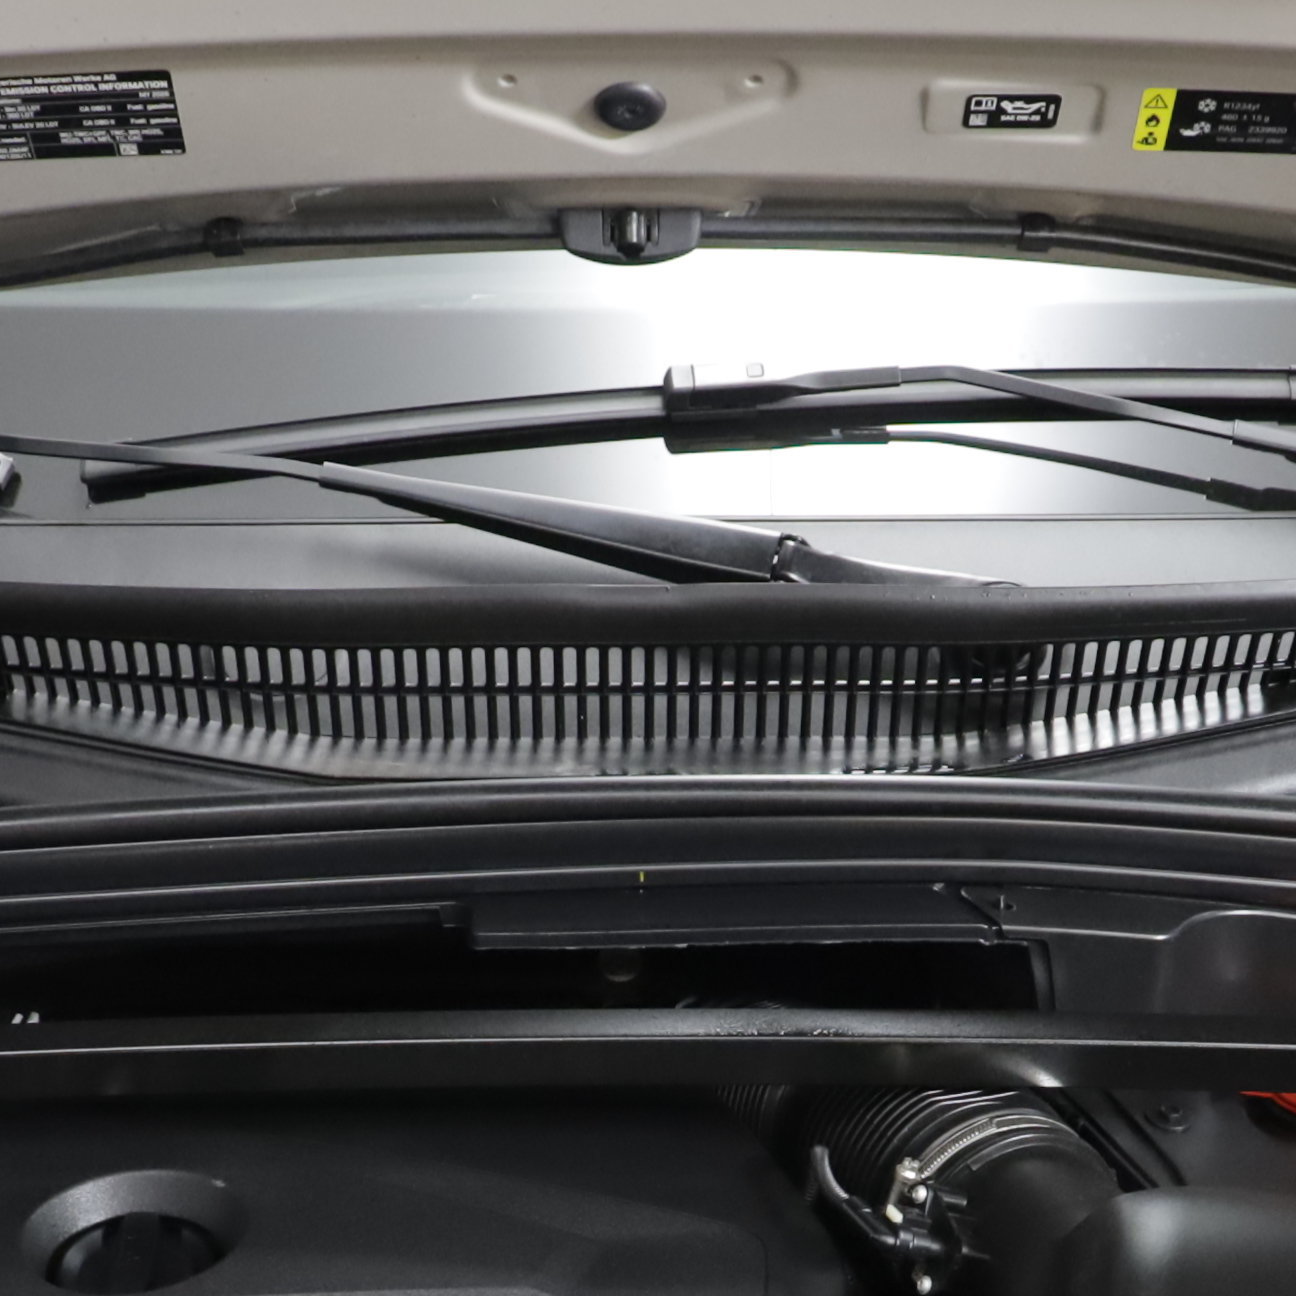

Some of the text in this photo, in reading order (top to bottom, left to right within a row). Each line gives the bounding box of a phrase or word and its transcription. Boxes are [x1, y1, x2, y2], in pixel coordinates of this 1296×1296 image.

[33, 76, 73, 84] Motoren
[73, 75, 102, 83] Werke
[103, 73, 117, 81] AG
[0, 85, 49, 96] EMISSION
[50, 83, 97, 94] CONTROL
[98, 80, 169, 91] INFORMATION
